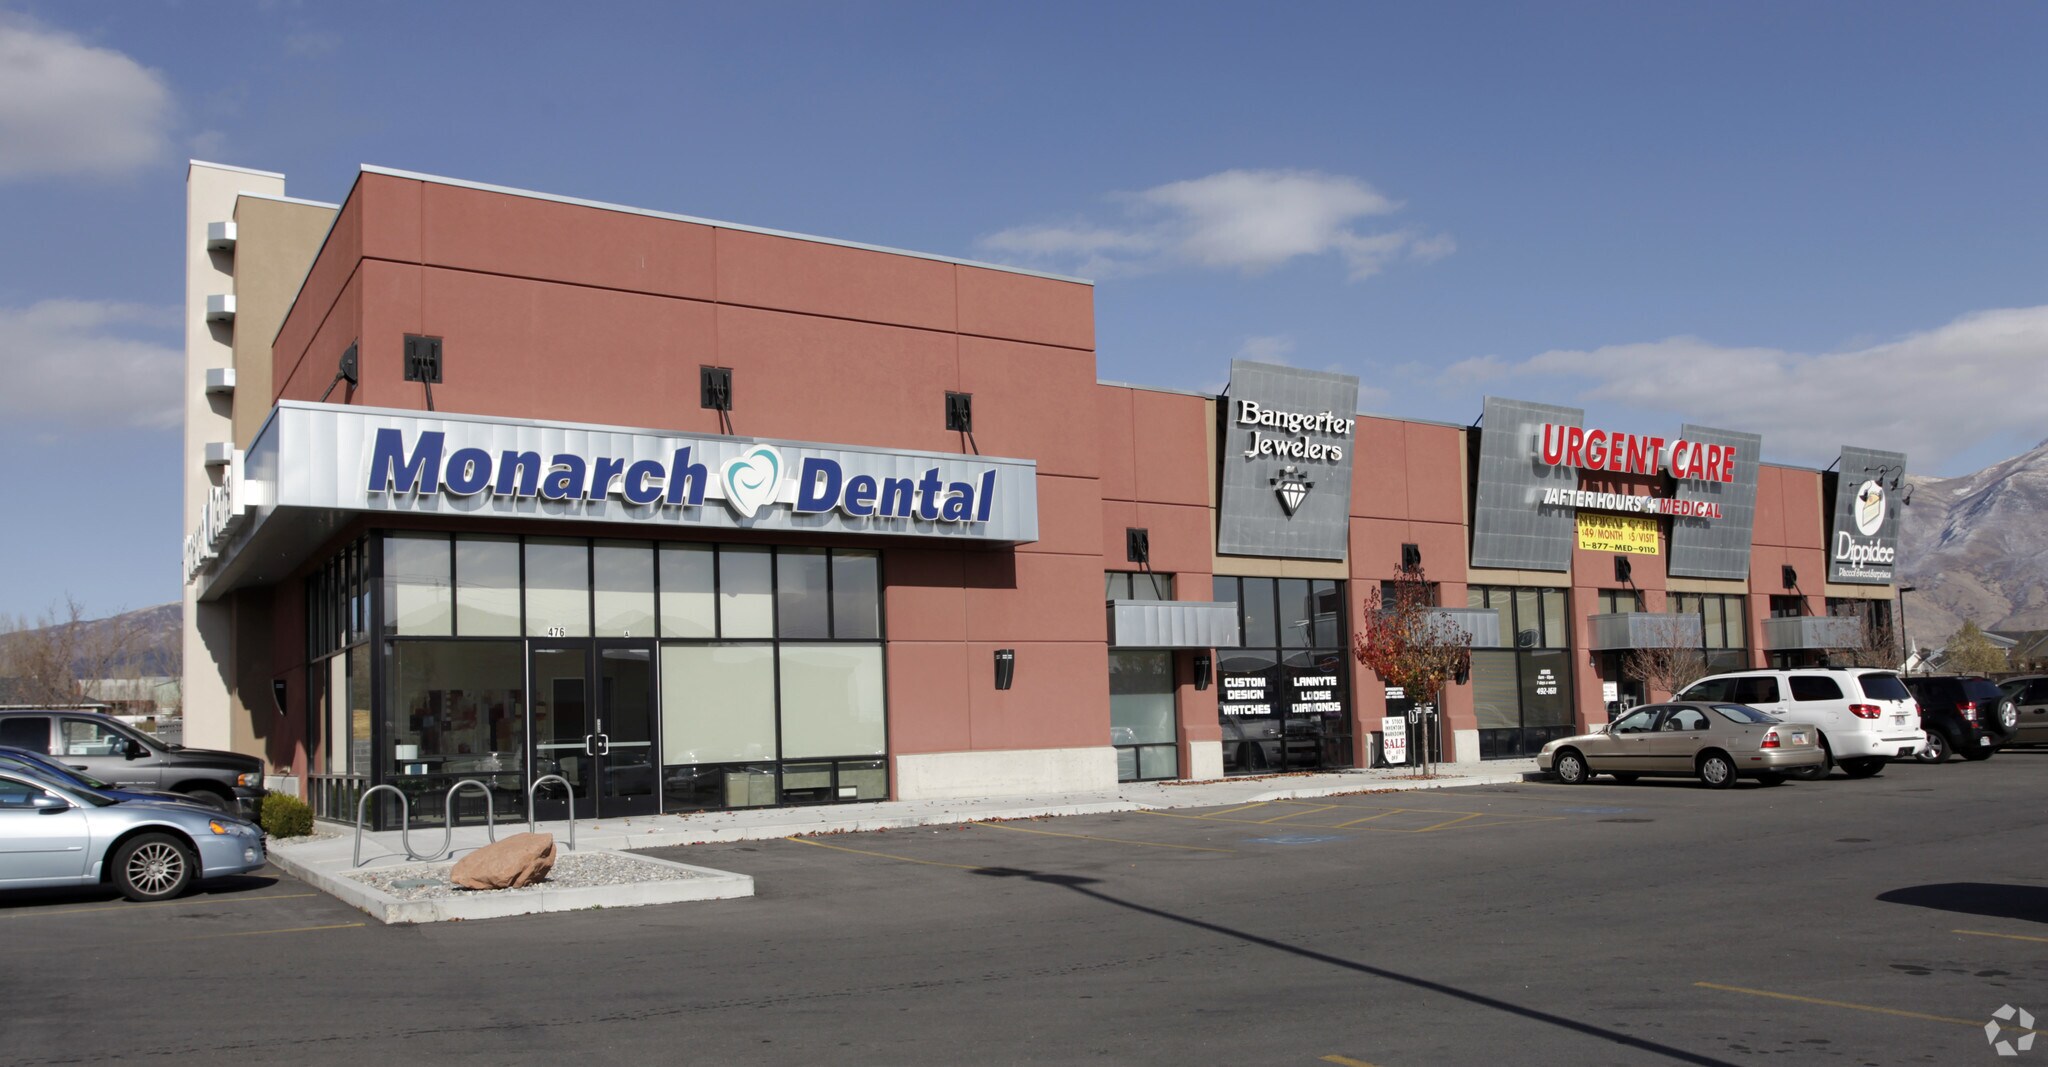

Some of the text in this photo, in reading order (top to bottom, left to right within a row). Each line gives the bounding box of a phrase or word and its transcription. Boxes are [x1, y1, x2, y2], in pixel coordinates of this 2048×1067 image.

[1240, 400, 1355, 434] Bangerter
[1244, 431, 1343, 460] Jewelers
[1542, 423, 1736, 483] URGENT CARE
[367, 428, 998, 522] Monarch Dental
[1545, 488, 1723, 519] AFTER HOURS MEDICAL
[1579, 514, 1623, 528] MEDICAL
[1582, 541, 1656, 553] 1-877-MED-9110
[1836, 531, 1894, 568] Dippidee
[548, 627, 565, 637] 476
[1224, 678, 1266, 687] CUSTOM
[1227, 690, 1265, 700] DESIGN
[1301, 691, 1331, 701] LOOSE
[1223, 704, 1271, 715] WATCHES
[1292, 702, 1342, 713] DIAMONDS
[1384, 738, 1405, 749] SALE
